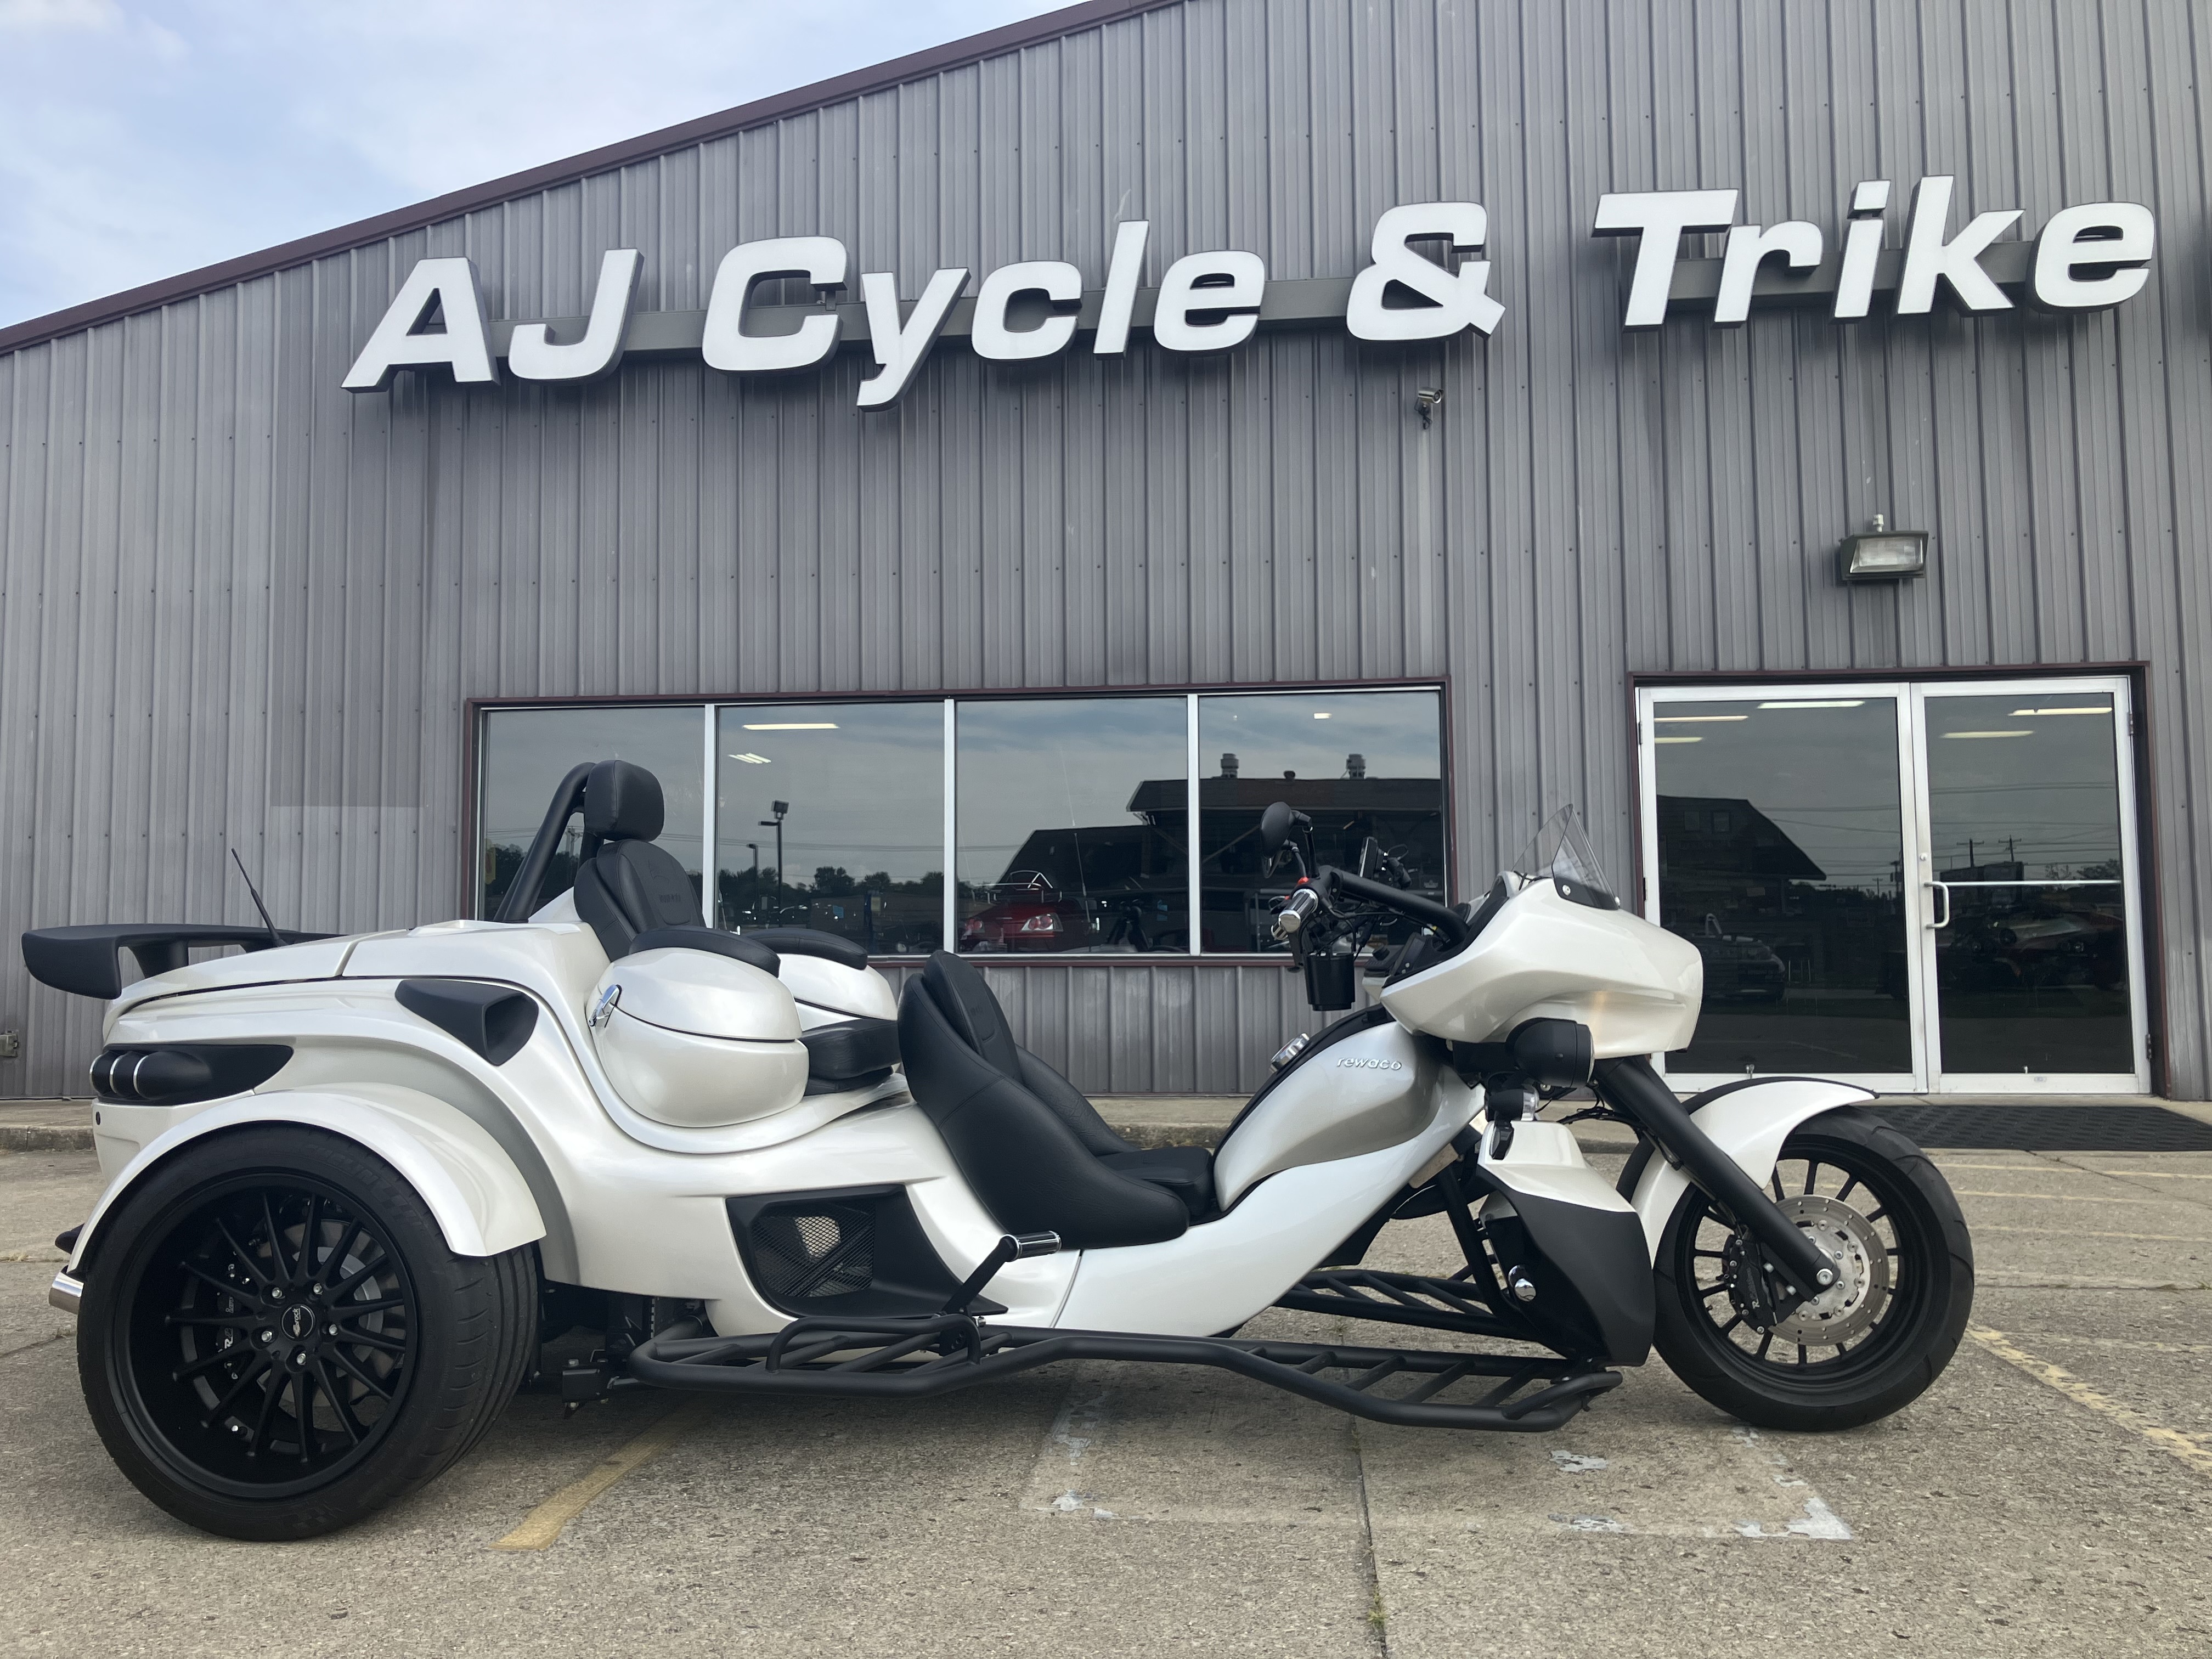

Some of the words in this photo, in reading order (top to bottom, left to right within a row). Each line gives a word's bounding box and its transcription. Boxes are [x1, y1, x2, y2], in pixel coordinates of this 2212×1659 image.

[341, 248, 644, 392] AJ
[702, 220, 1265, 411] Cycle
[1346, 201, 1506, 341] &
[1592, 174, 2155, 331] Trike
[1336, 1057, 1402, 1070] rewaco
